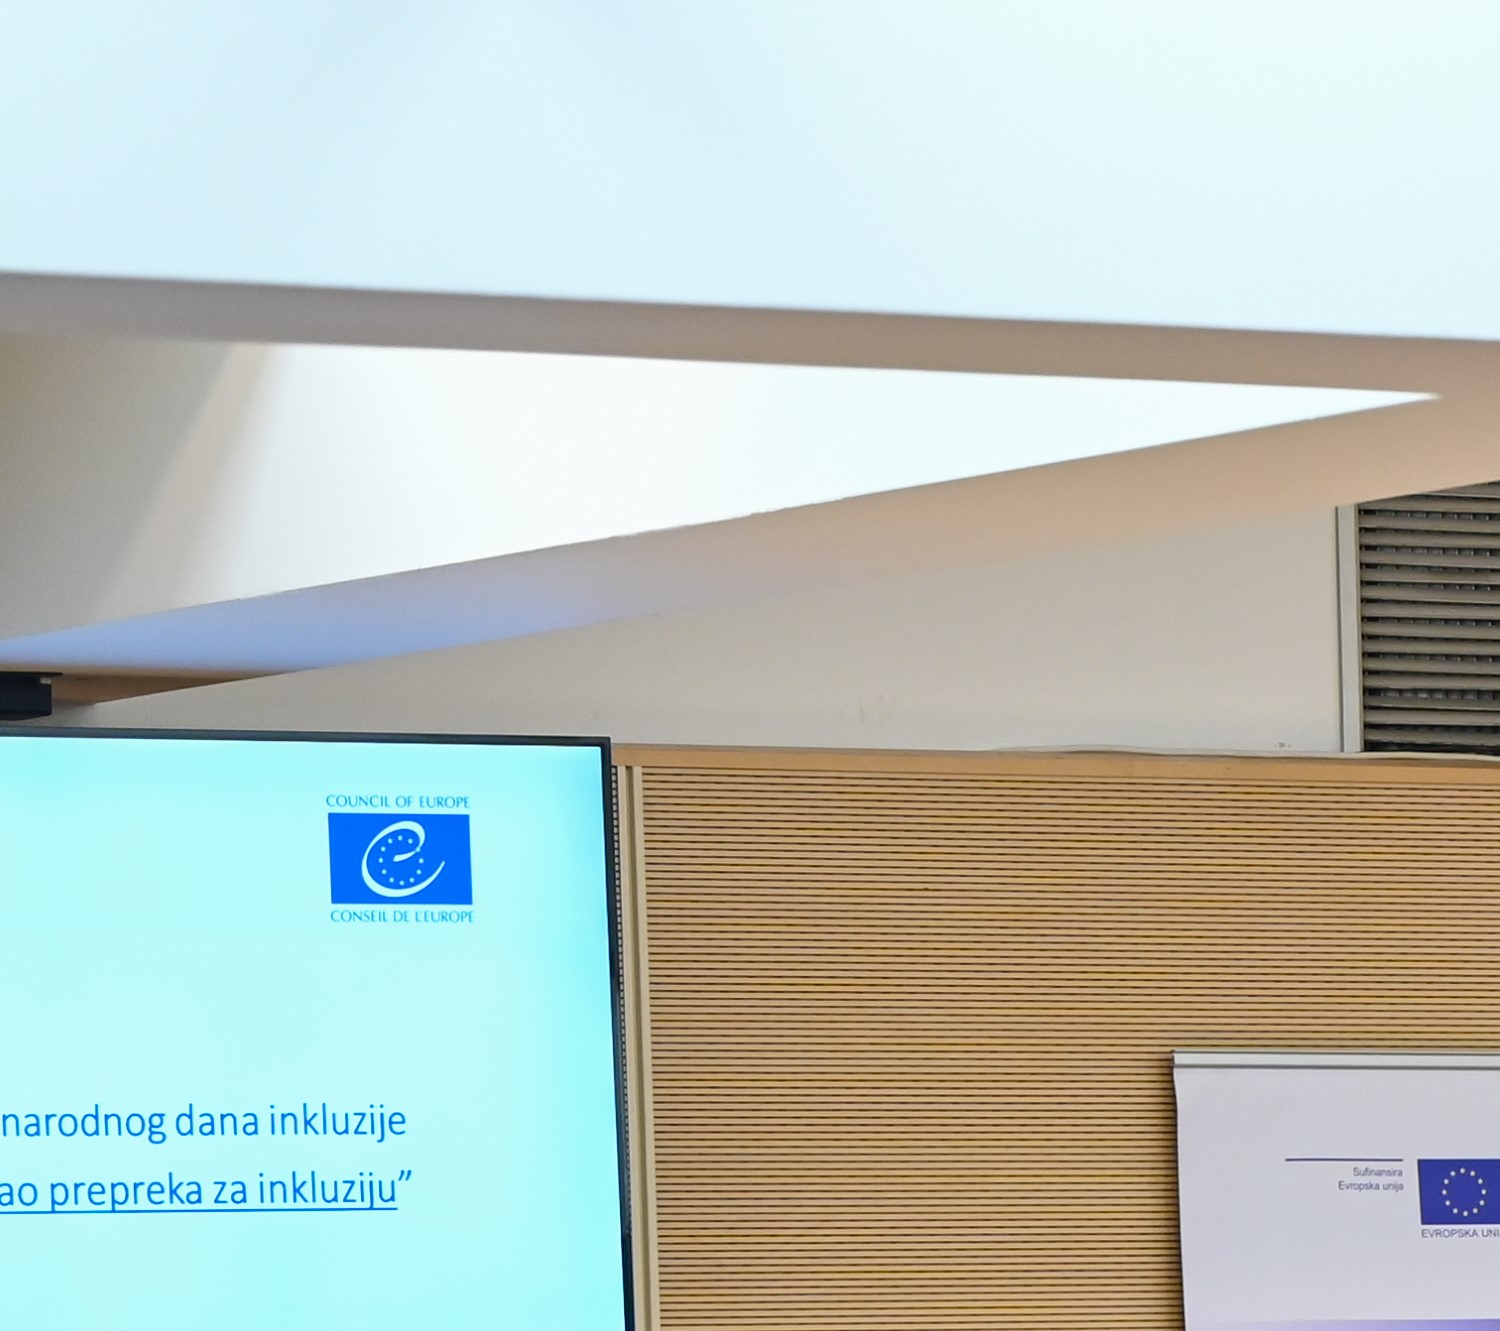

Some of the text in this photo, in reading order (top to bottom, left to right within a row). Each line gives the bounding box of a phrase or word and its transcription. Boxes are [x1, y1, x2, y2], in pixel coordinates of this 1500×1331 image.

[326, 794, 470, 808] COUNCIL OF EUROPE
[331, 910, 388, 922] CONSEIL
[394, 911, 409, 922] DE
[2, 1103, 406, 1144] narodnog dana inkluzije
[1353, 1167, 1403, 1177] Sufinansira
[0, 1181, 38, 1207] ao
[50, 1172, 202, 1212] prepreka
[213, 1180, 247, 1204] za
[1338, 1181, 1403, 1192] Evropska unija
[1422, 1229, 1478, 1238] EVROPSKA
